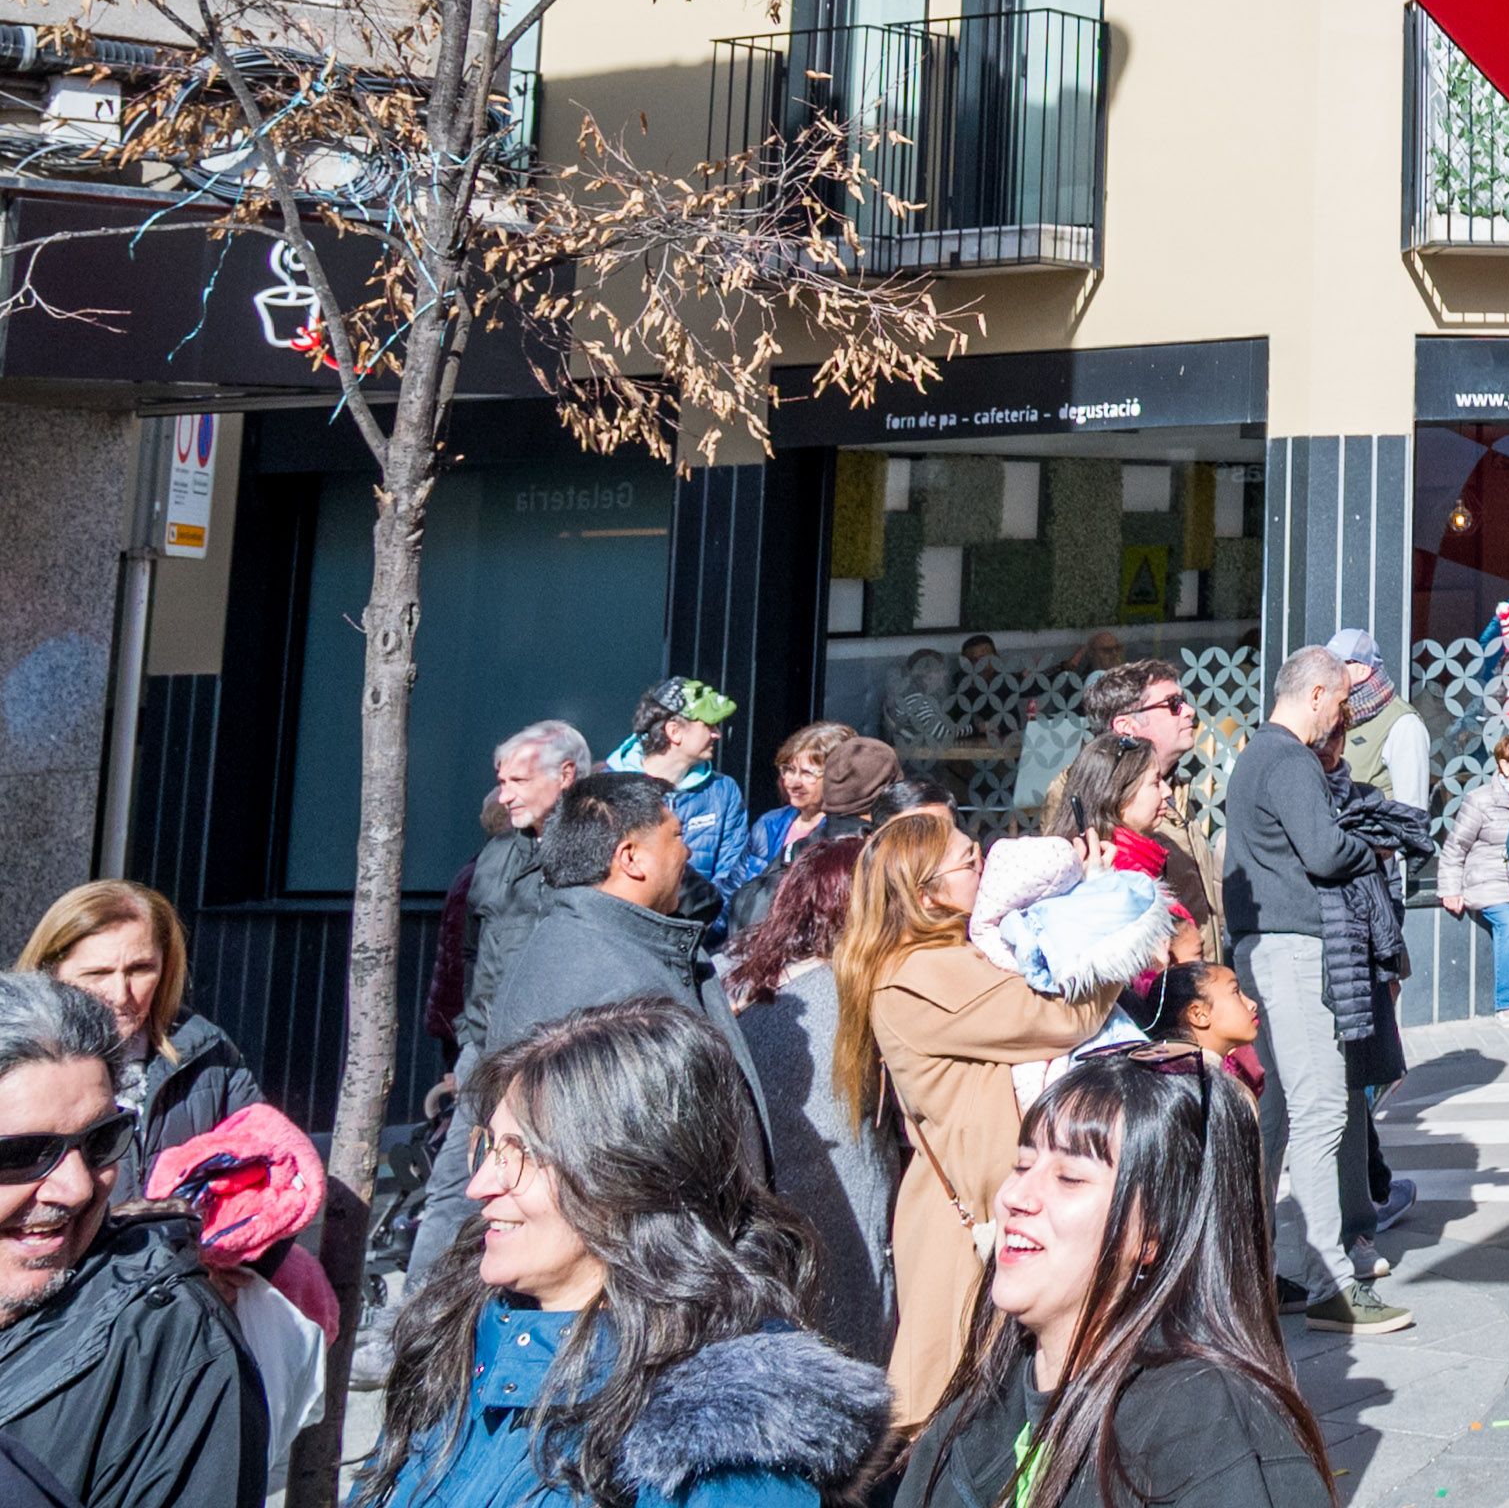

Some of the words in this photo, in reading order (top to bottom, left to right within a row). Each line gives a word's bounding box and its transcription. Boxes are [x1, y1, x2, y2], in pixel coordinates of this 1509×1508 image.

[885, 412, 916, 430] forn
[918, 410, 935, 428] de
[938, 411, 957, 432] pa
[1058, 397, 1142, 425] degustació
